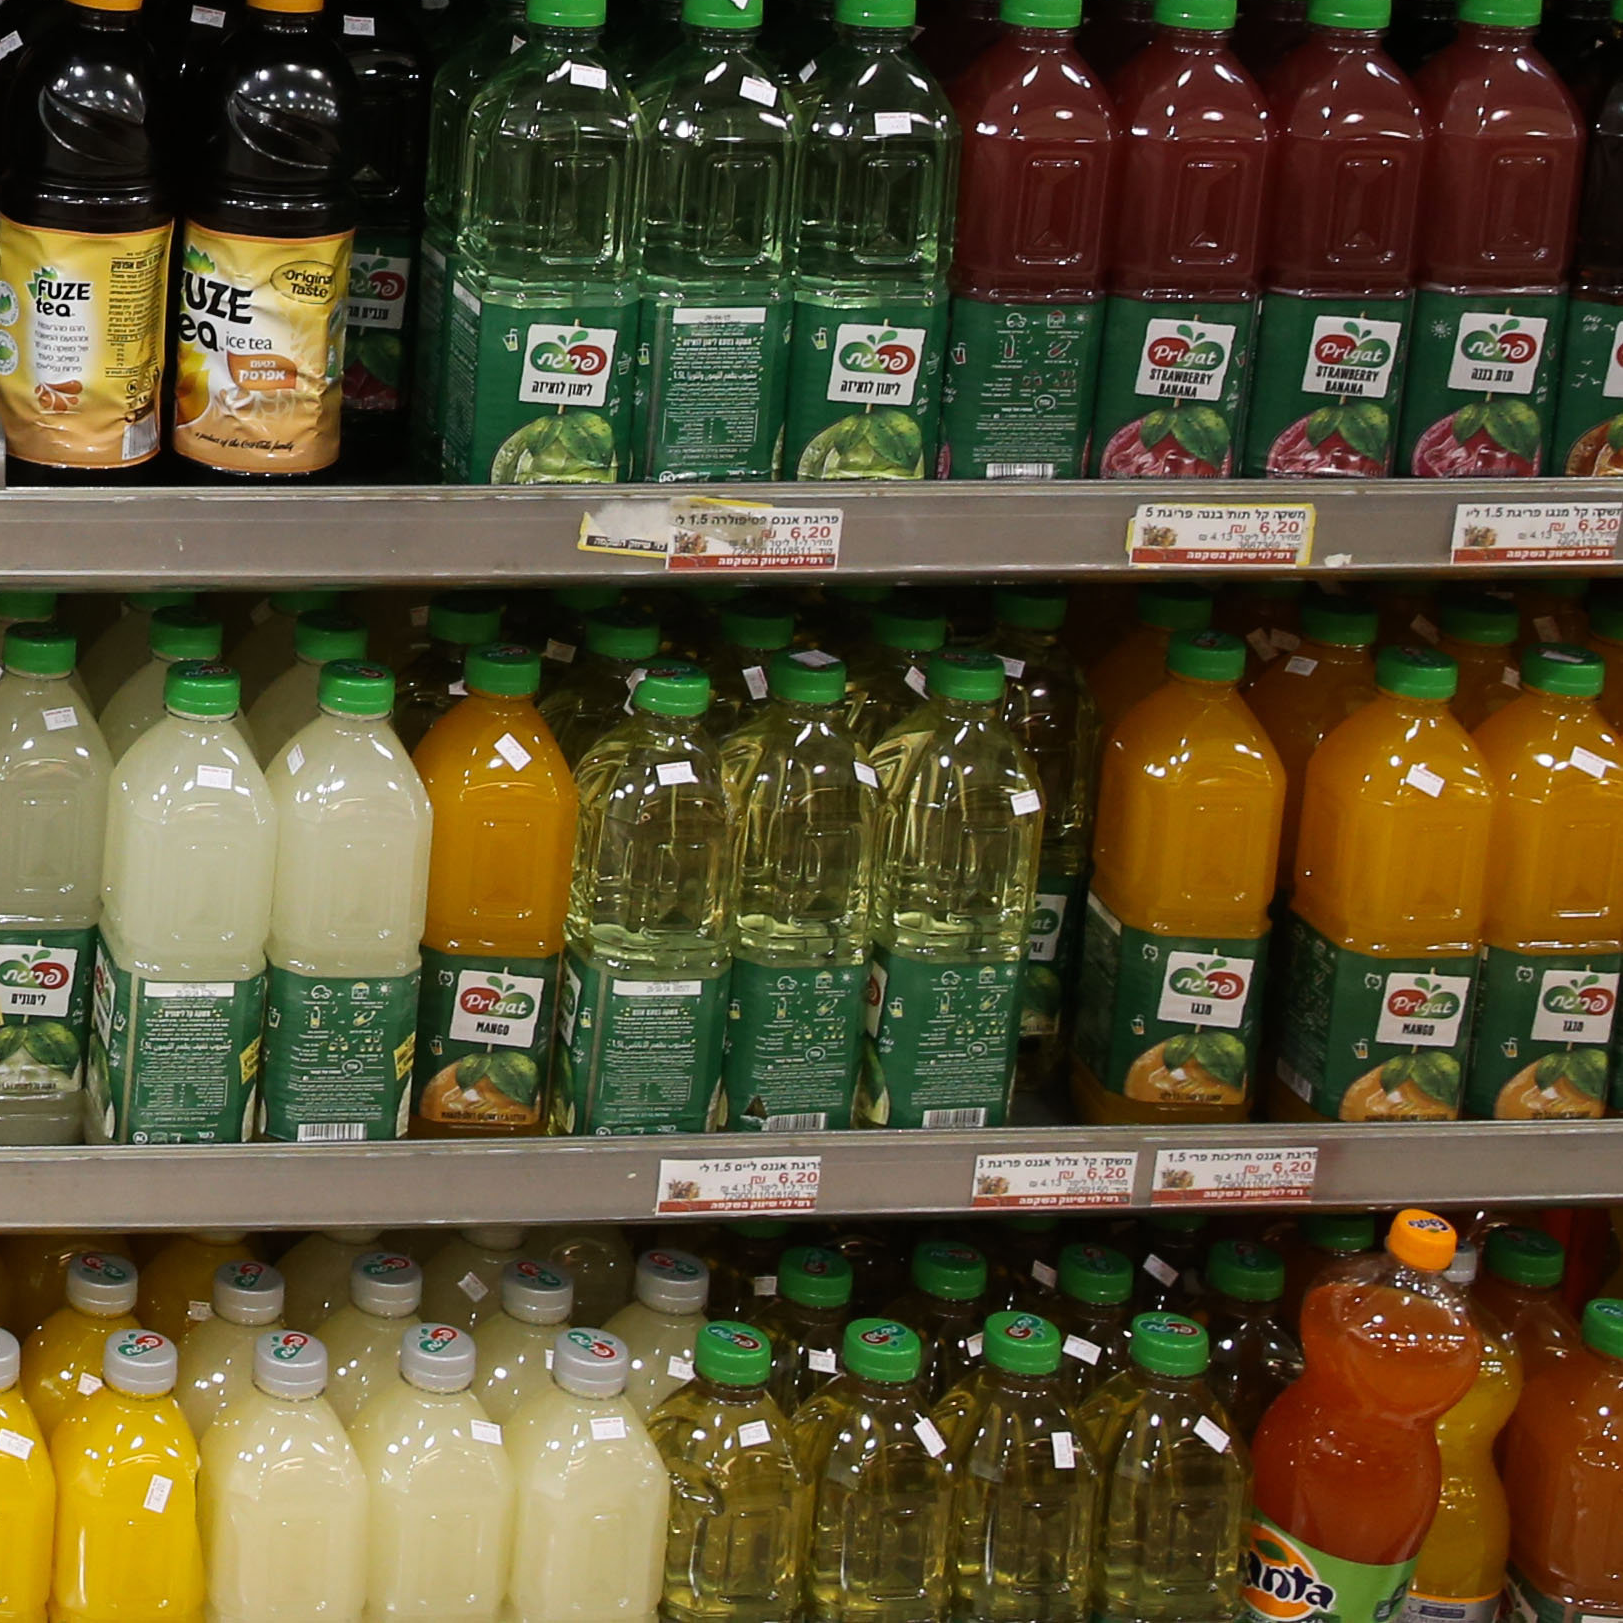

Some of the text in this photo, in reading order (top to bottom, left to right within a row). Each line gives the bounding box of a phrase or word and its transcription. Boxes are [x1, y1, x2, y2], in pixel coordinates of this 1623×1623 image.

[35, 279, 93, 302] FUZE
[290, 283, 328, 299] Taste
[35, 298, 74, 318] tea
[226, 335, 272, 350] ice tea
[1154, 345, 1225, 366] Prigat
[238, 369, 286, 382] אפרסק
[1149, 367, 1213, 386] STRAWBERRY
[1315, 366, 1378, 384] STRAWBERRY
[1158, 383, 1198, 398] BANANA
[1324, 381, 1364, 396] BANANA
[790, 527, 831, 539] 6.20
[476, 1022, 510, 1037] MANGO
[1402, 1022, 1435, 1036] MANGO
[779, 1172, 817, 1183] 6.20
[1087, 1166, 1127, 1179] 6.20
